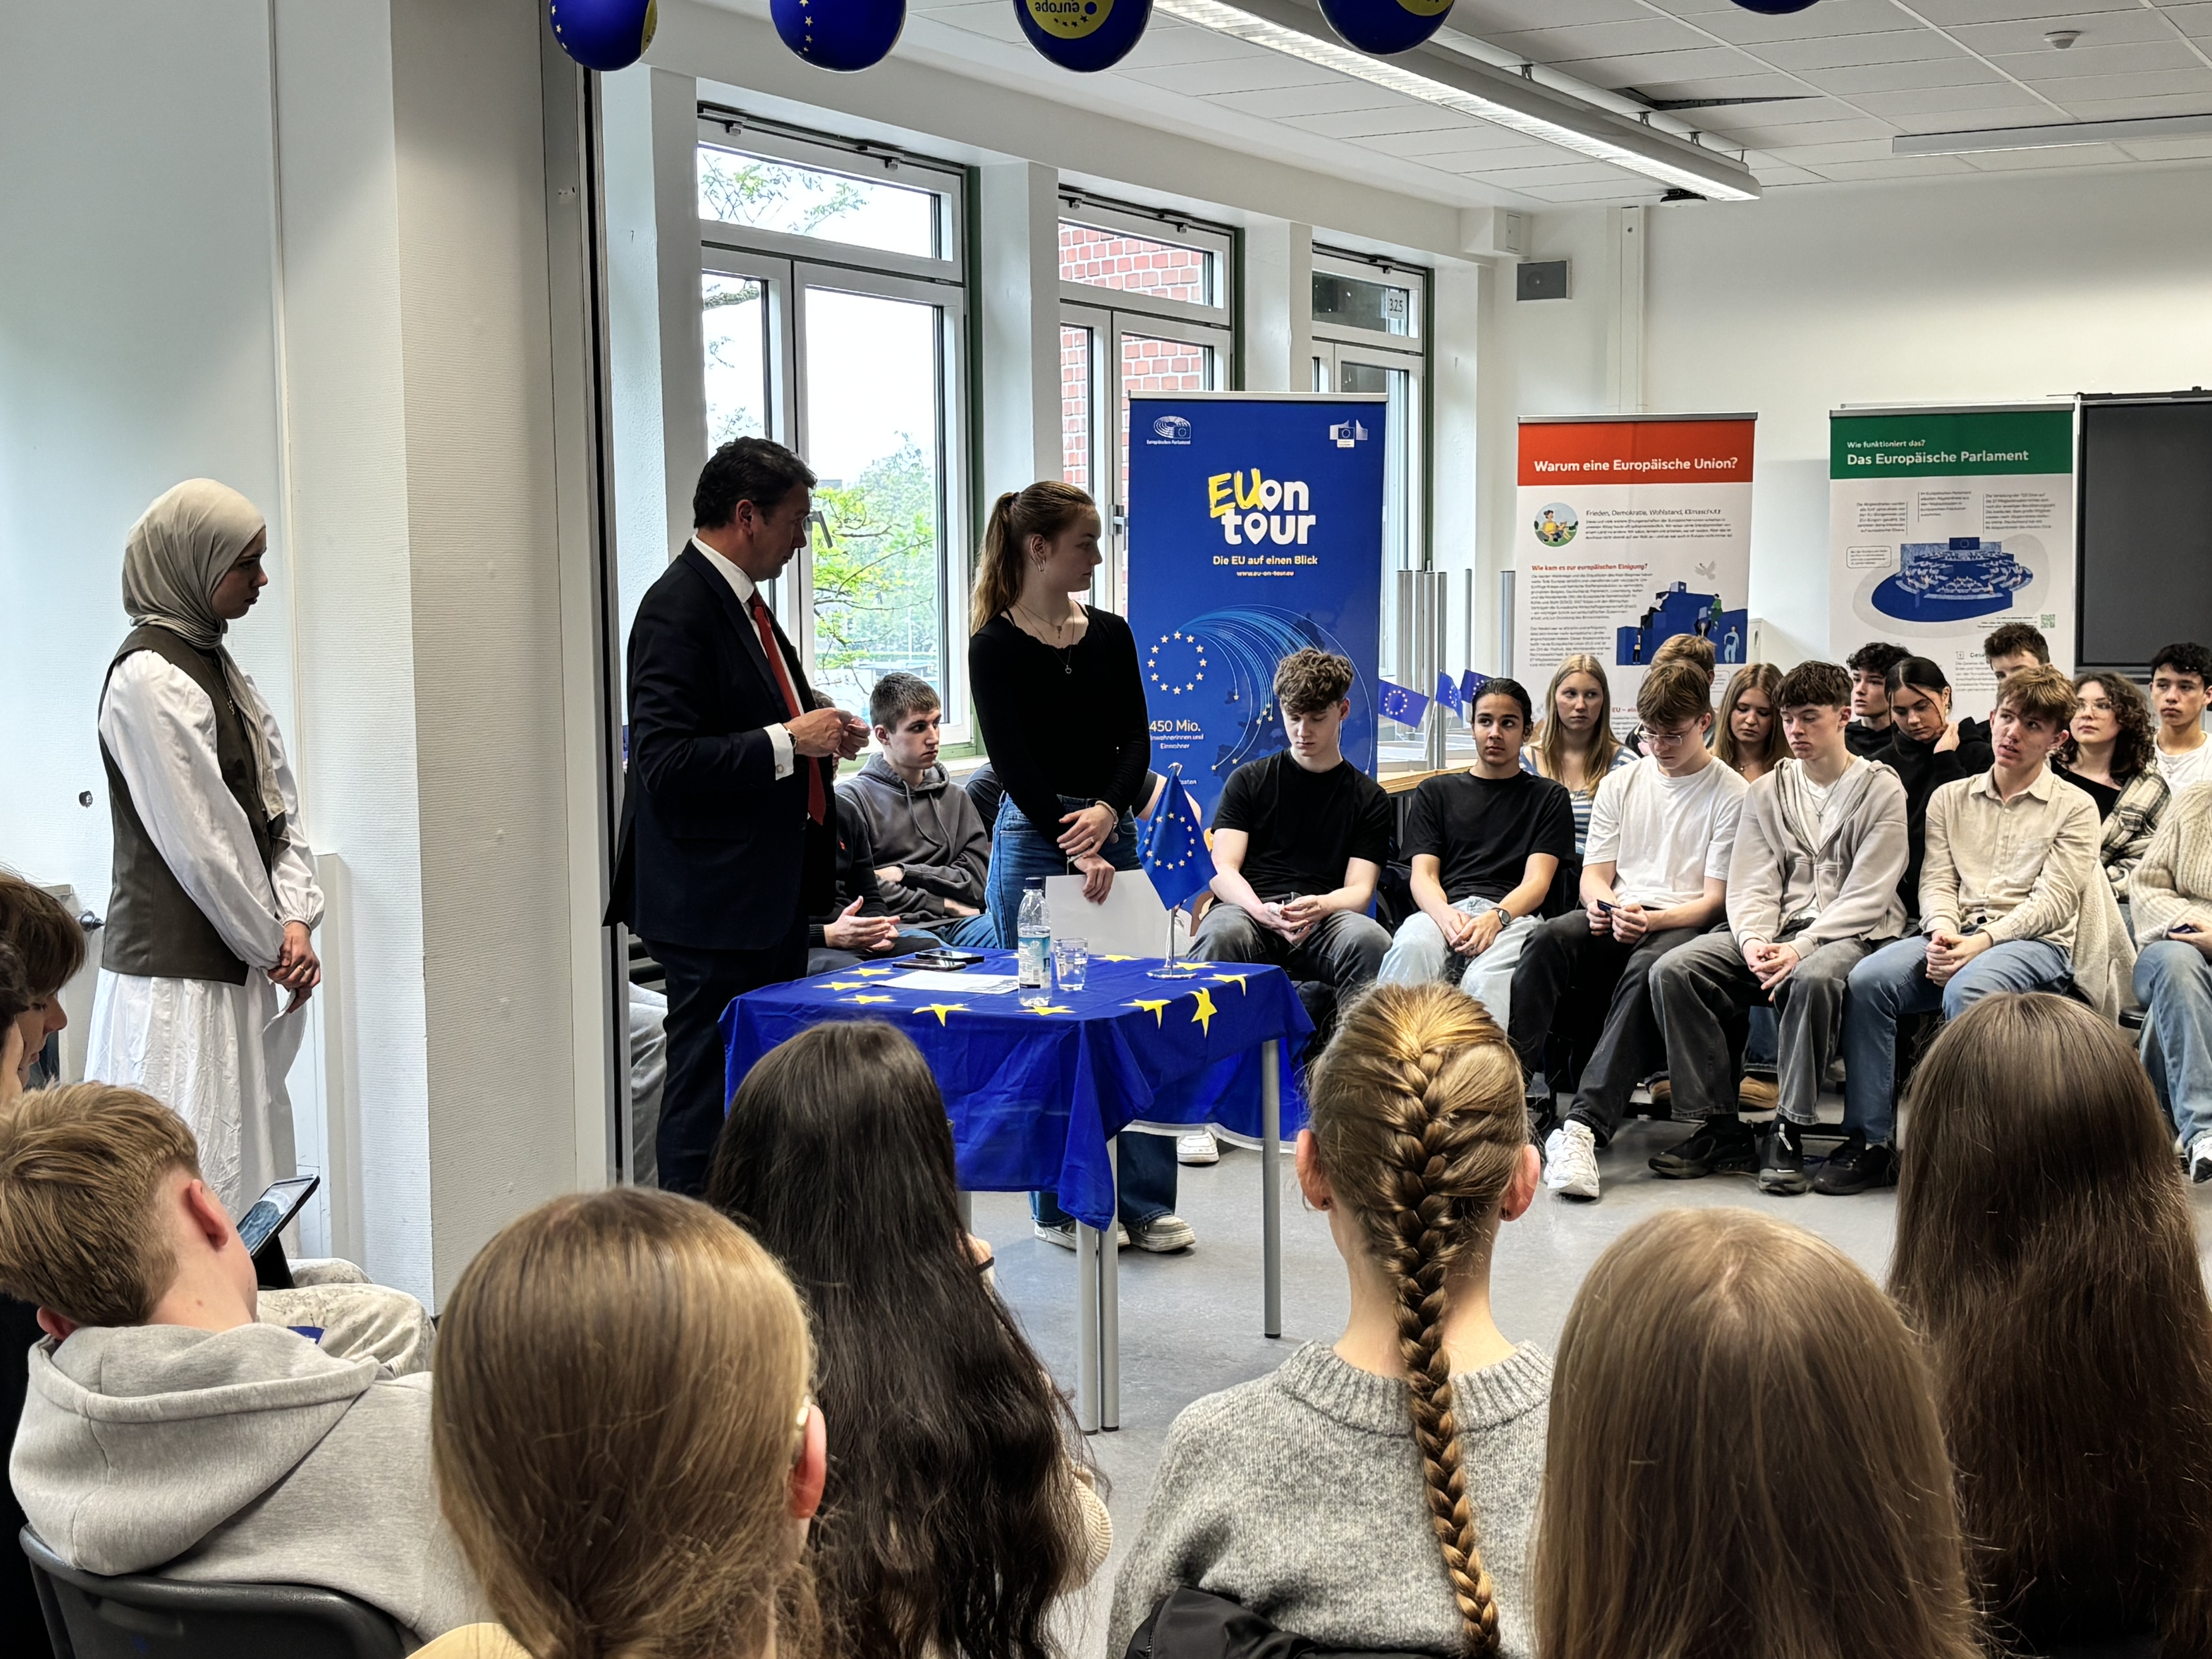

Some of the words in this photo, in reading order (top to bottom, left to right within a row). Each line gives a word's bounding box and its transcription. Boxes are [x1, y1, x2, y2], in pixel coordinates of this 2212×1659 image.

[1035, 2, 1080, 13] europe
[1389, 298, 1403, 313] 325
[1534, 460, 1580, 472] Warum
[1583, 459, 1609, 471] eine
[1613, 459, 1690, 472] Europäische
[1694, 457, 1738, 469] Union?
[1847, 454, 1872, 465] Das
[1876, 452, 1957, 465] Europäische
[1961, 450, 2029, 462] Parlament
[1221, 508, 1316, 545] tour
[1213, 556, 1229, 565] Die
[1231, 556, 1245, 565] EU
[1248, 555, 1264, 565] auf
[1266, 555, 1292, 565] einen
[1294, 555, 1318, 565] Blick
[1149, 720, 1173, 732] 450
[1176, 719, 1201, 732] Mio.
